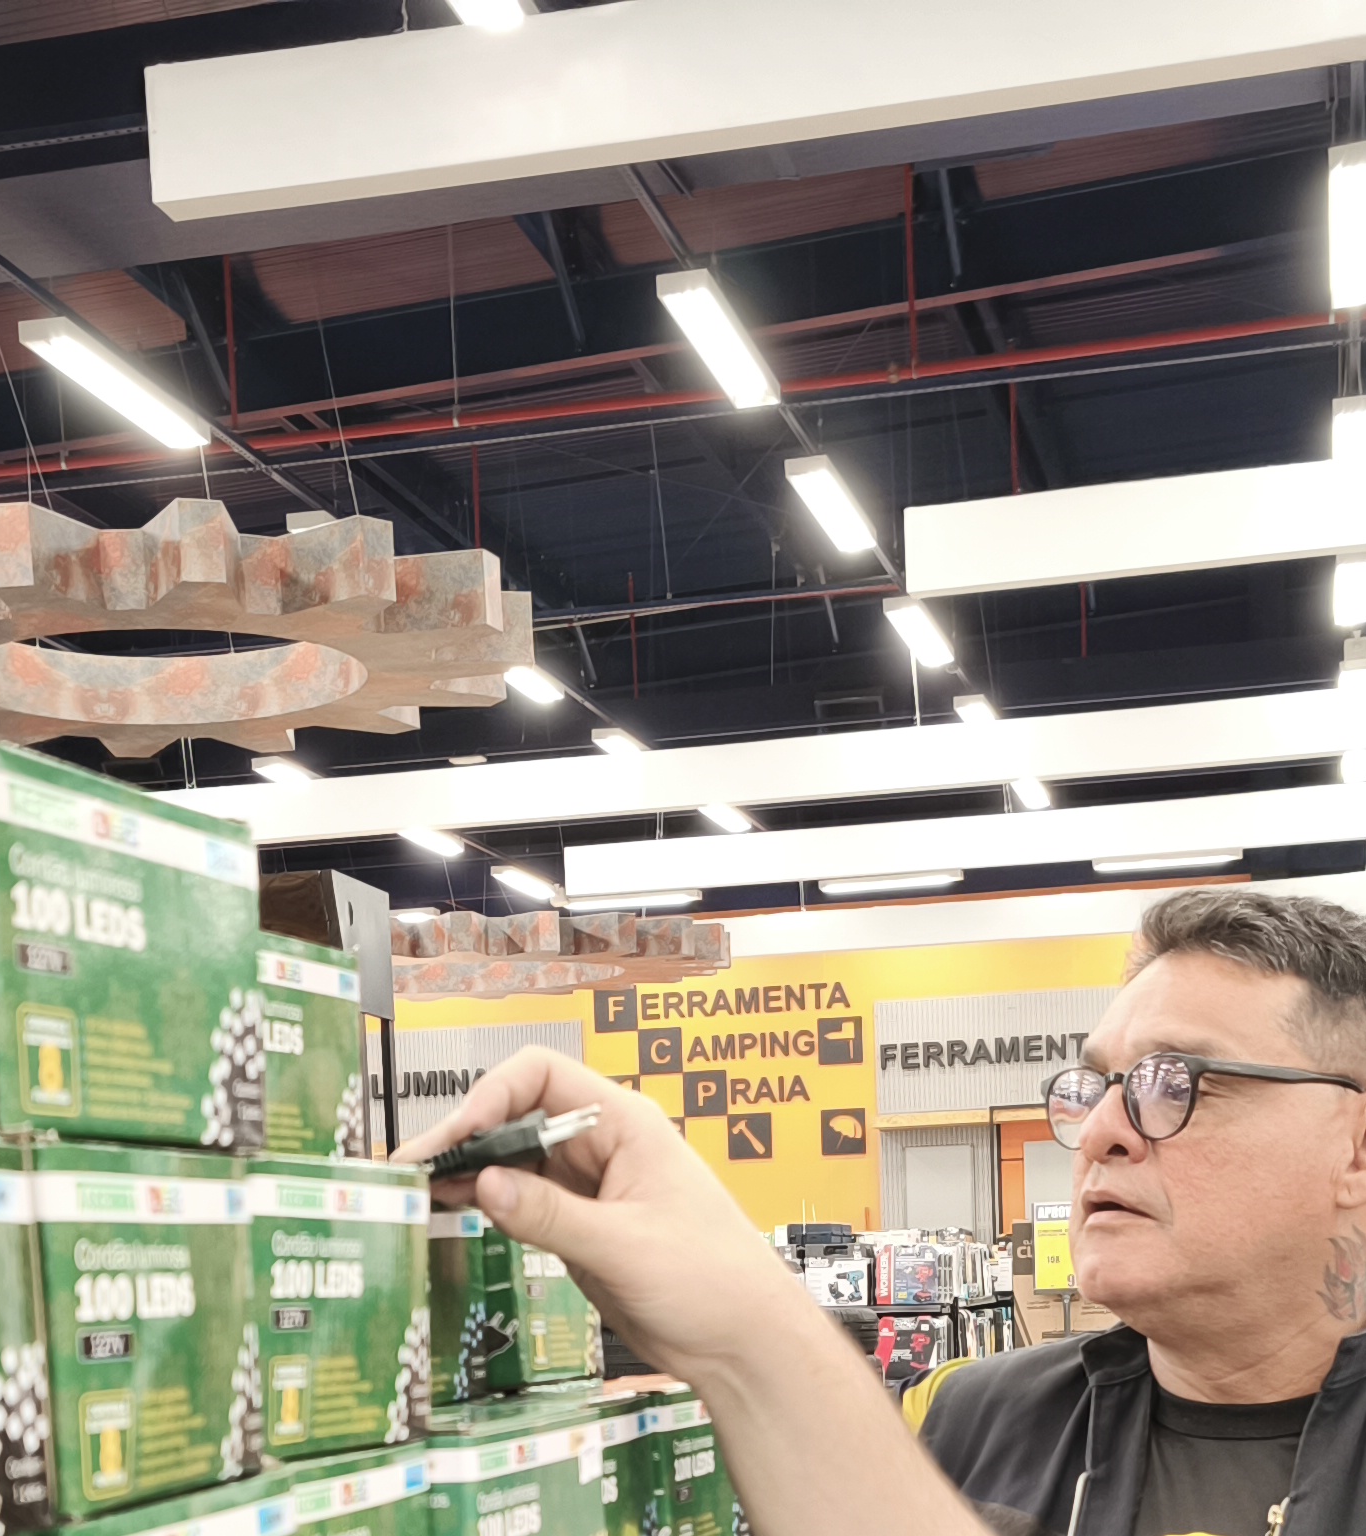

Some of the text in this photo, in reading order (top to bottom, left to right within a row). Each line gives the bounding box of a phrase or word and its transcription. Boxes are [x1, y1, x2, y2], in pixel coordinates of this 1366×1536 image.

[9, 882, 147, 952] 100 LEDS
[74, 1272, 197, 1324] 100 LEDS
[270, 1259, 365, 1299] 100 LEDS
[880, 1252, 888, 1297] WORKER
